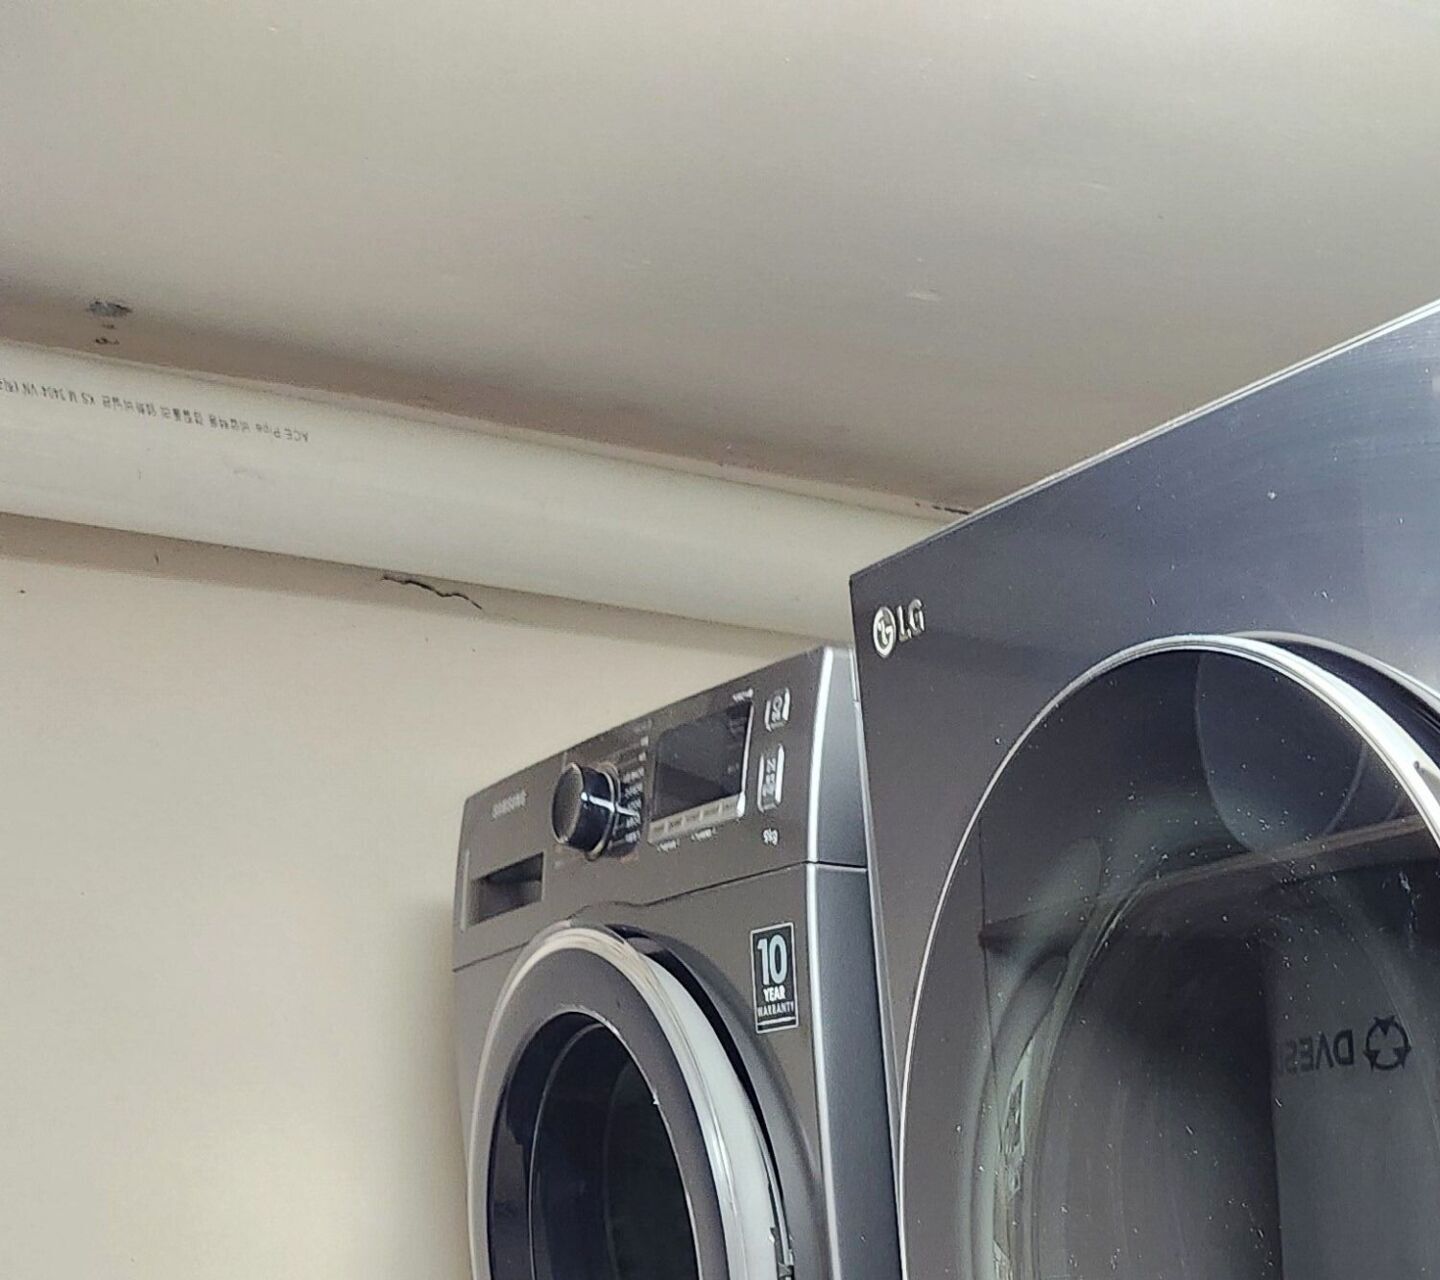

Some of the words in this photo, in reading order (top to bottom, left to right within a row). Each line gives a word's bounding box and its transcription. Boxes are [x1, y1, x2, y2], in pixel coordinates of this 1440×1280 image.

[896, 598, 925, 643] LG
[757, 934, 788, 986] 10
[762, 985, 786, 1003] YEAR
